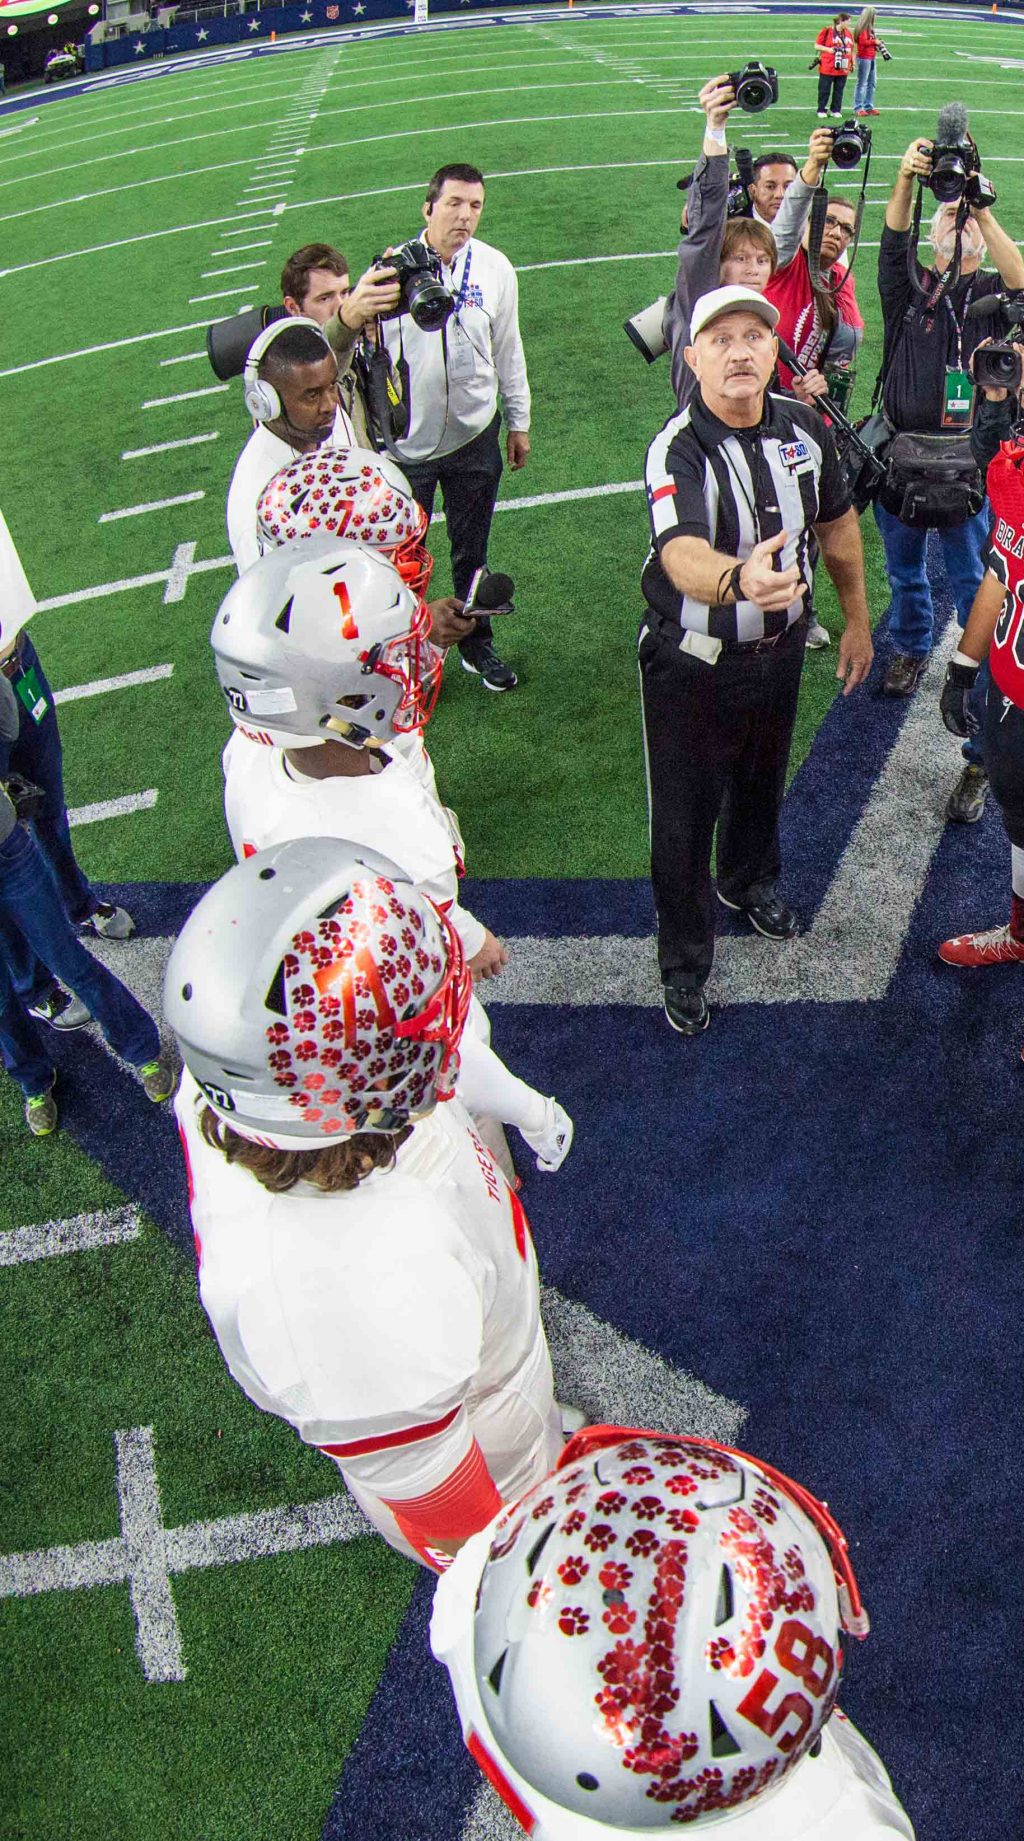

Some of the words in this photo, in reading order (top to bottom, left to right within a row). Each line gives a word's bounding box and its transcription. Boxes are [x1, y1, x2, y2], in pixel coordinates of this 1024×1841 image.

[956, 384, 962, 398] 1
[333, 499, 355, 537] 7
[332, 581, 359, 640] 1
[736, 1619, 835, 1753] 58
